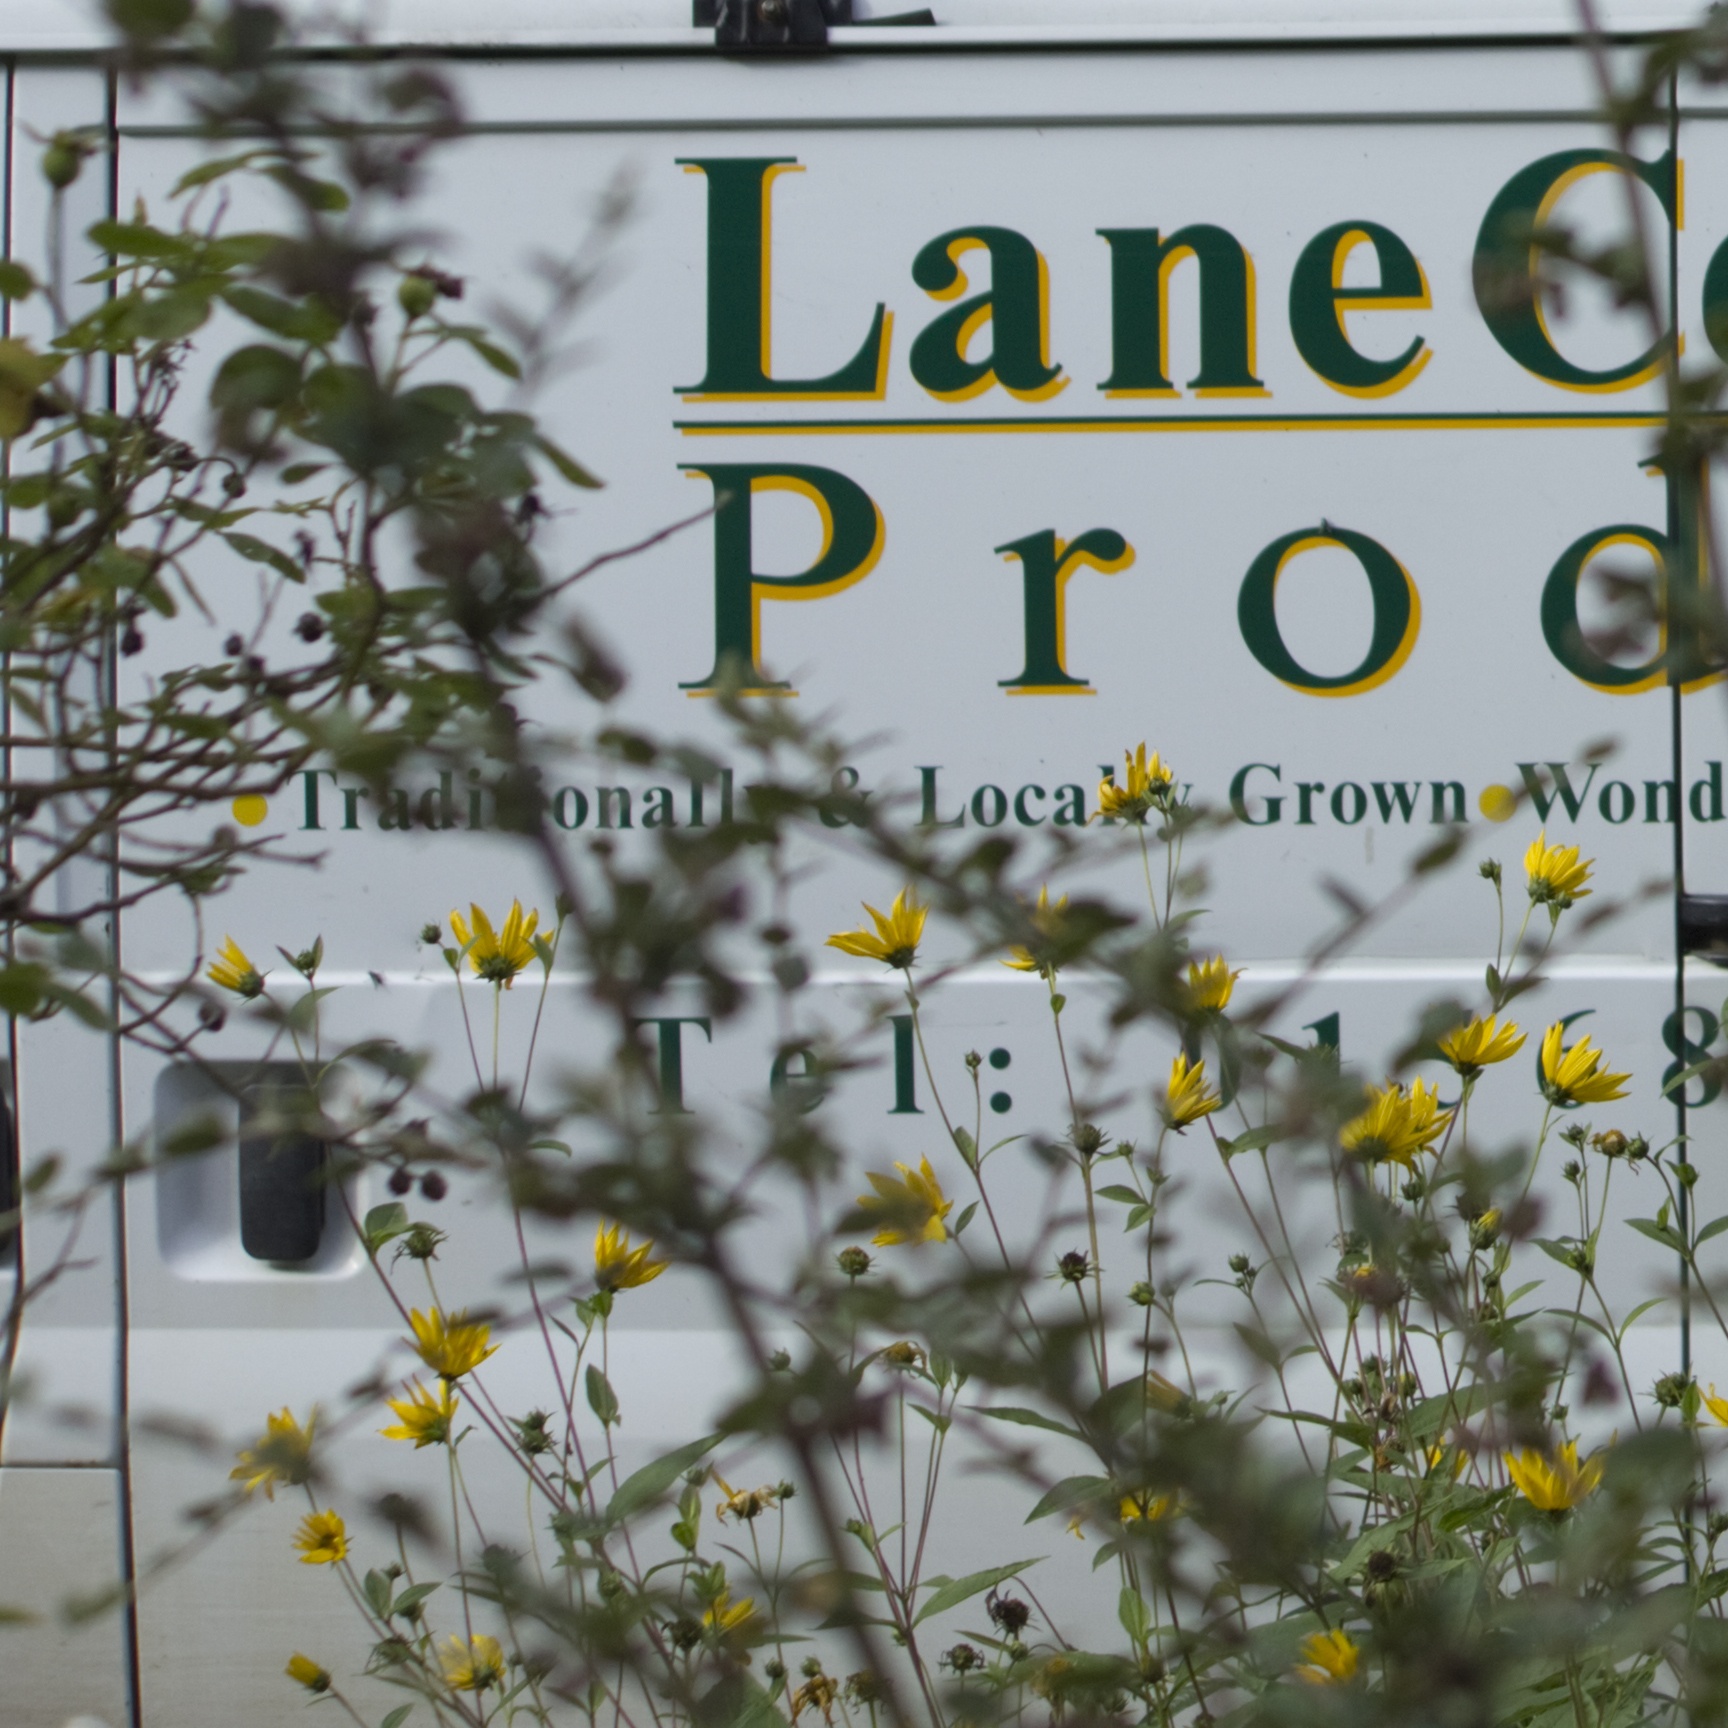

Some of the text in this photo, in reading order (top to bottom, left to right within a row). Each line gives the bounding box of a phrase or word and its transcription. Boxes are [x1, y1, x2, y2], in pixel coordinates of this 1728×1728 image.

[287, 767, 776, 843] Tradionall
[914, 764, 1194, 842] Local
[1229, 763, 1468, 826] Grown
[633, 1014, 1012, 1114] Tel:
